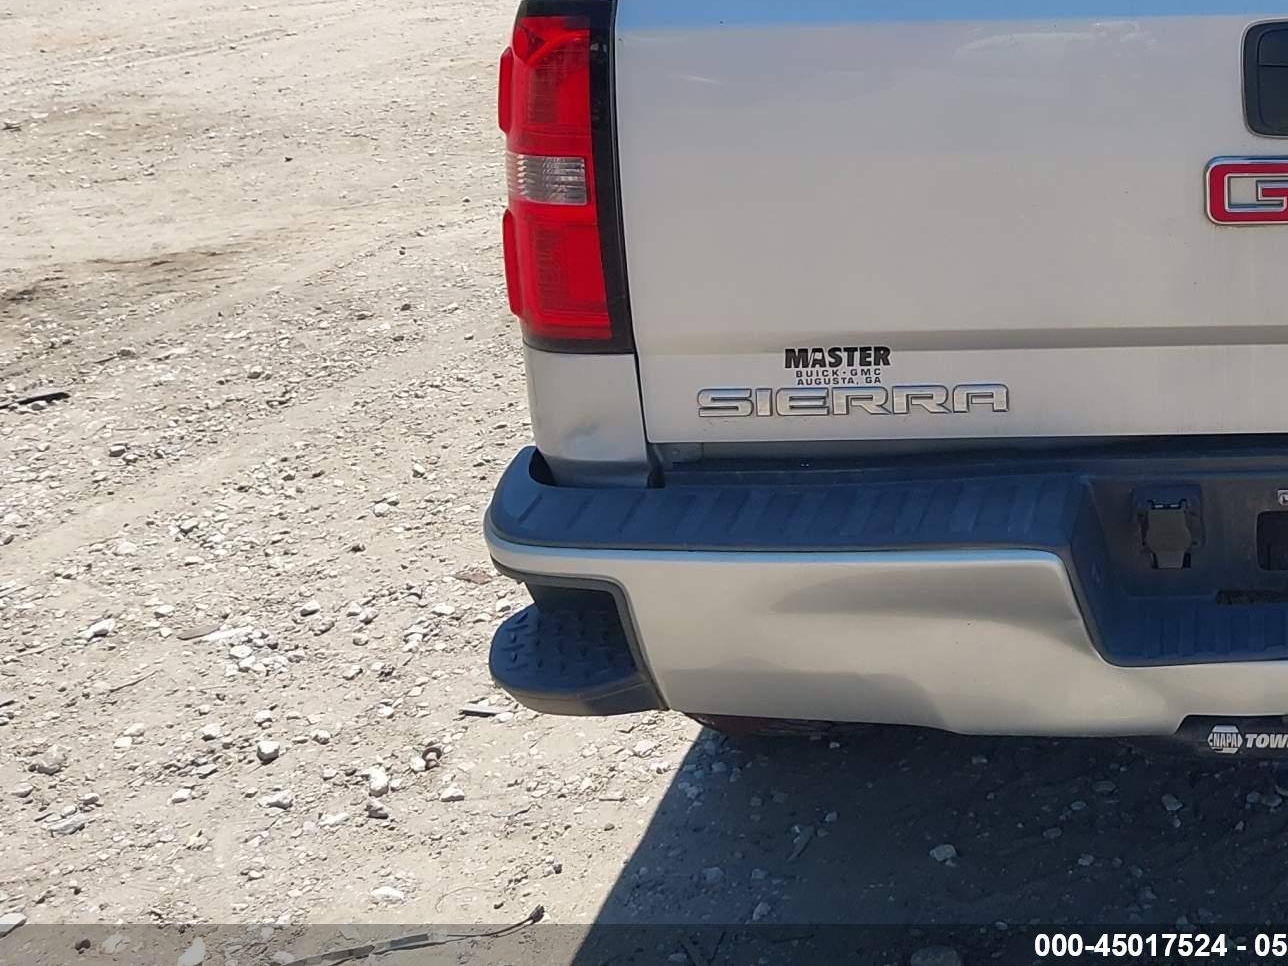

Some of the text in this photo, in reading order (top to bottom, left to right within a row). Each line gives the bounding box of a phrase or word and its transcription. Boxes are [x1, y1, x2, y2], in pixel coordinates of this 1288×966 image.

[784, 346, 892, 369] MASTER
[864, 376, 882, 384] GA
[697, 383, 1009, 417] SIERRA
